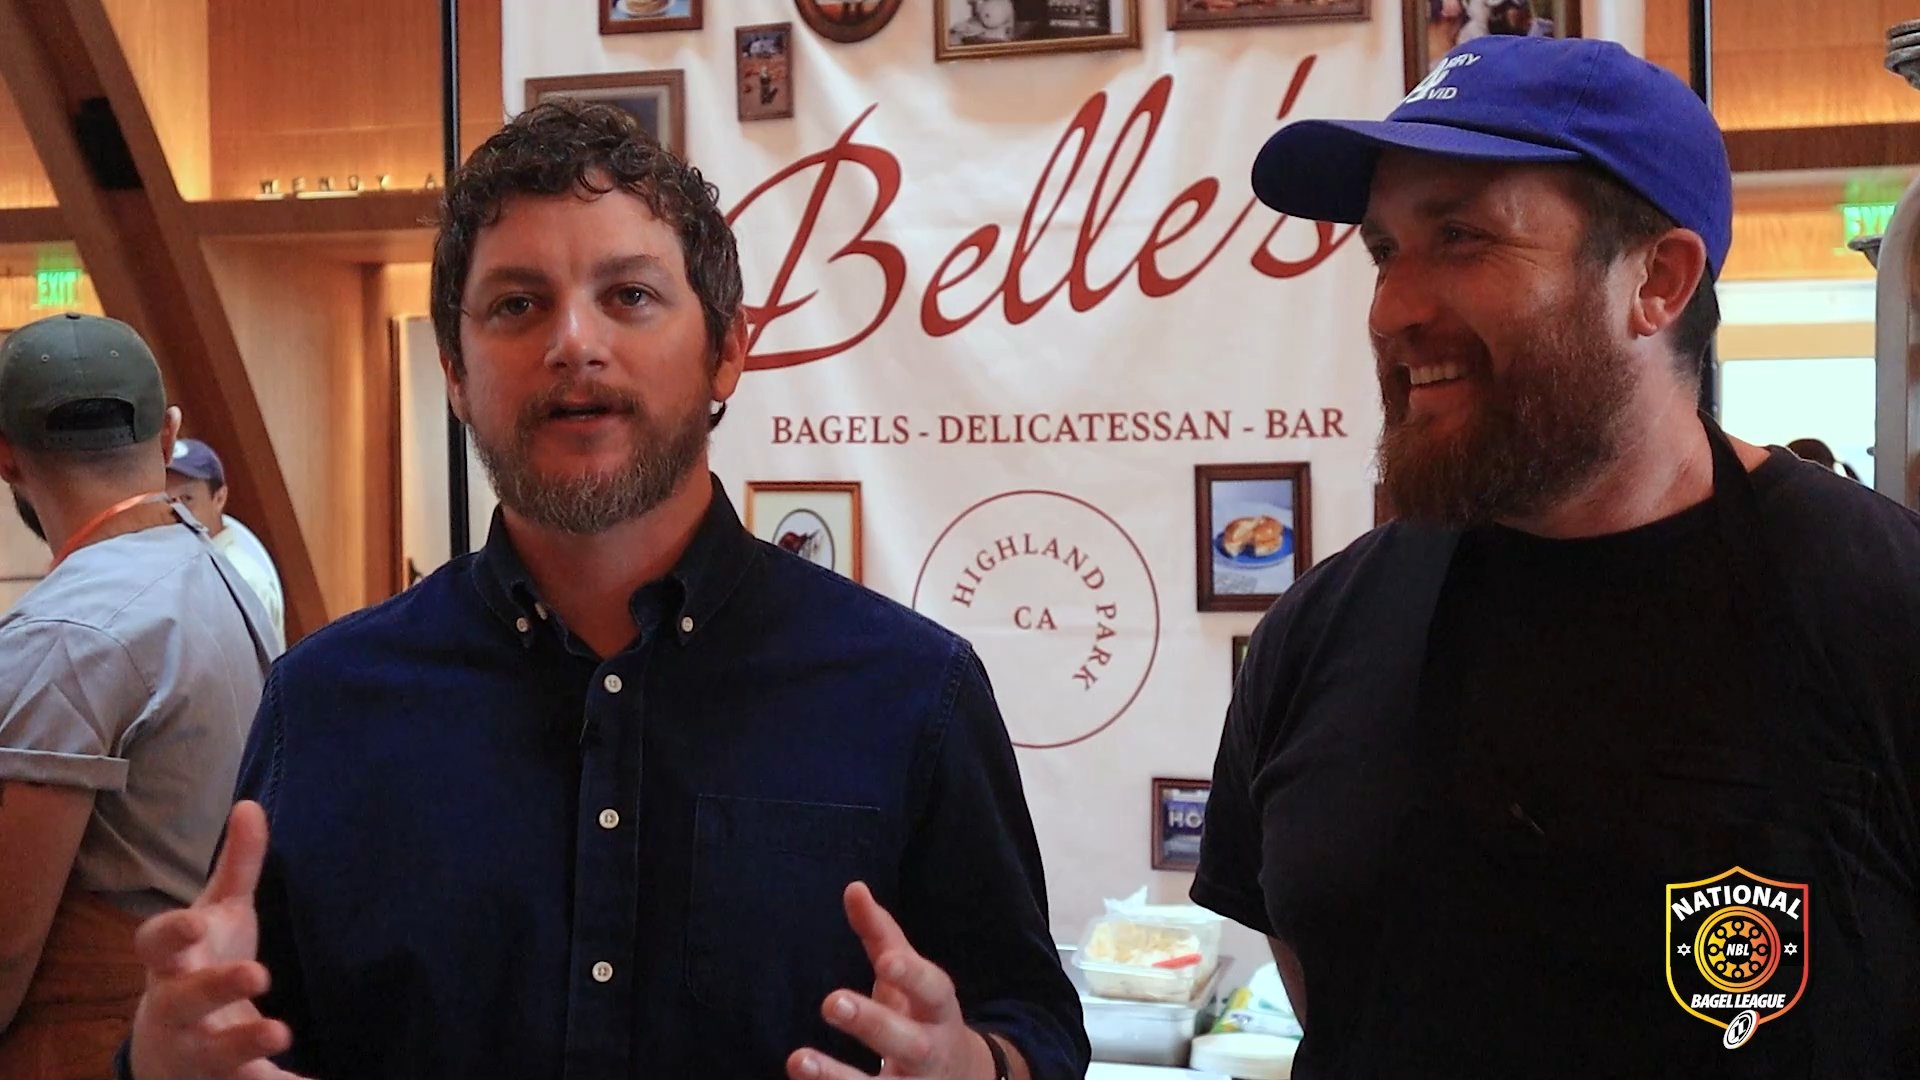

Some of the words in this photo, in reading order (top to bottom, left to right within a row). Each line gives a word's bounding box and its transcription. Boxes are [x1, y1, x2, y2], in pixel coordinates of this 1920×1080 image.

[725, 53, 1359, 372] Belle's
[37, 271, 77, 306] EXIT
[771, 415, 910, 444] BAGELS
[938, 410, 1232, 444] DELICATESSAN
[1265, 407, 1348, 439] BAR
[952, 533, 1105, 608] HIGHLAND
[1072, 601, 1118, 691] PARK
[1013, 606, 1058, 631] CA
[1168, 810, 1204, 828] HO
